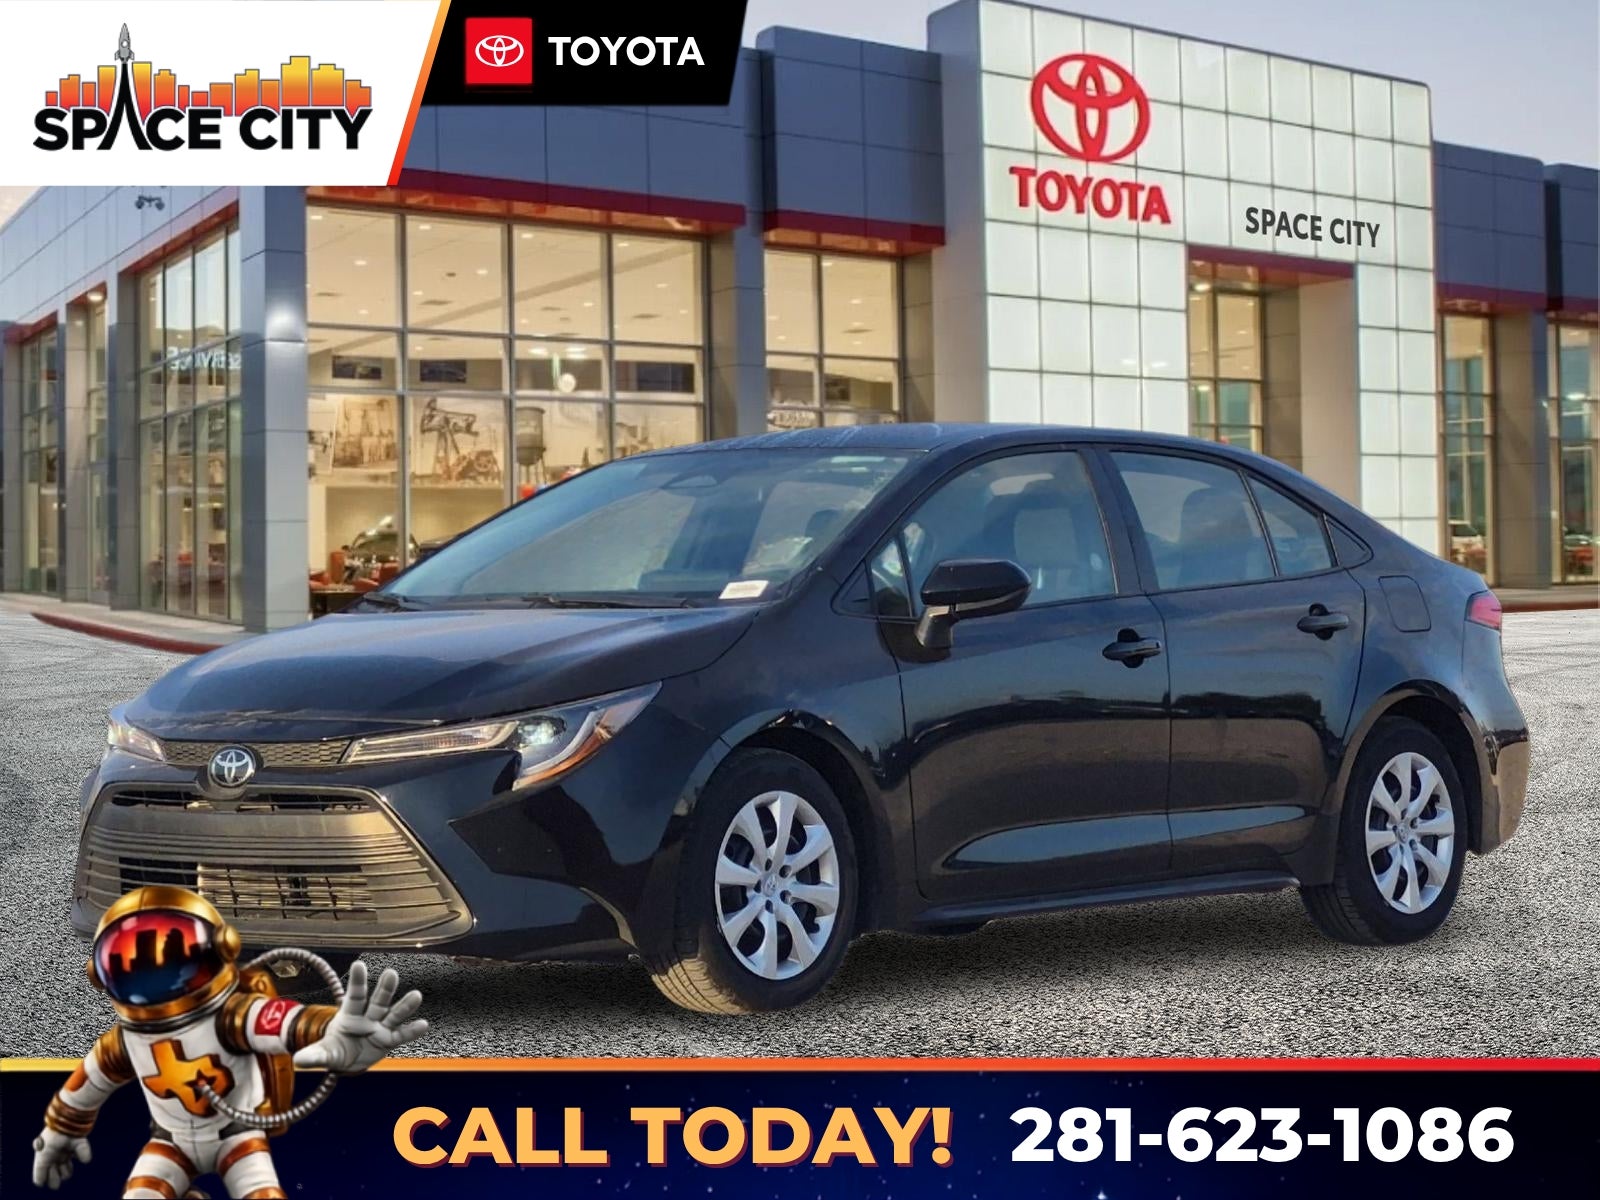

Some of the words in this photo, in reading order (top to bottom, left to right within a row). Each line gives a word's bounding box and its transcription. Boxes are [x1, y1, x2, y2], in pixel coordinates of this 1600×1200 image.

[1009, 166, 1172, 225] TOYOTA
[1245, 206, 1323, 242] SPACE
[1329, 217, 1381, 248] CITY
